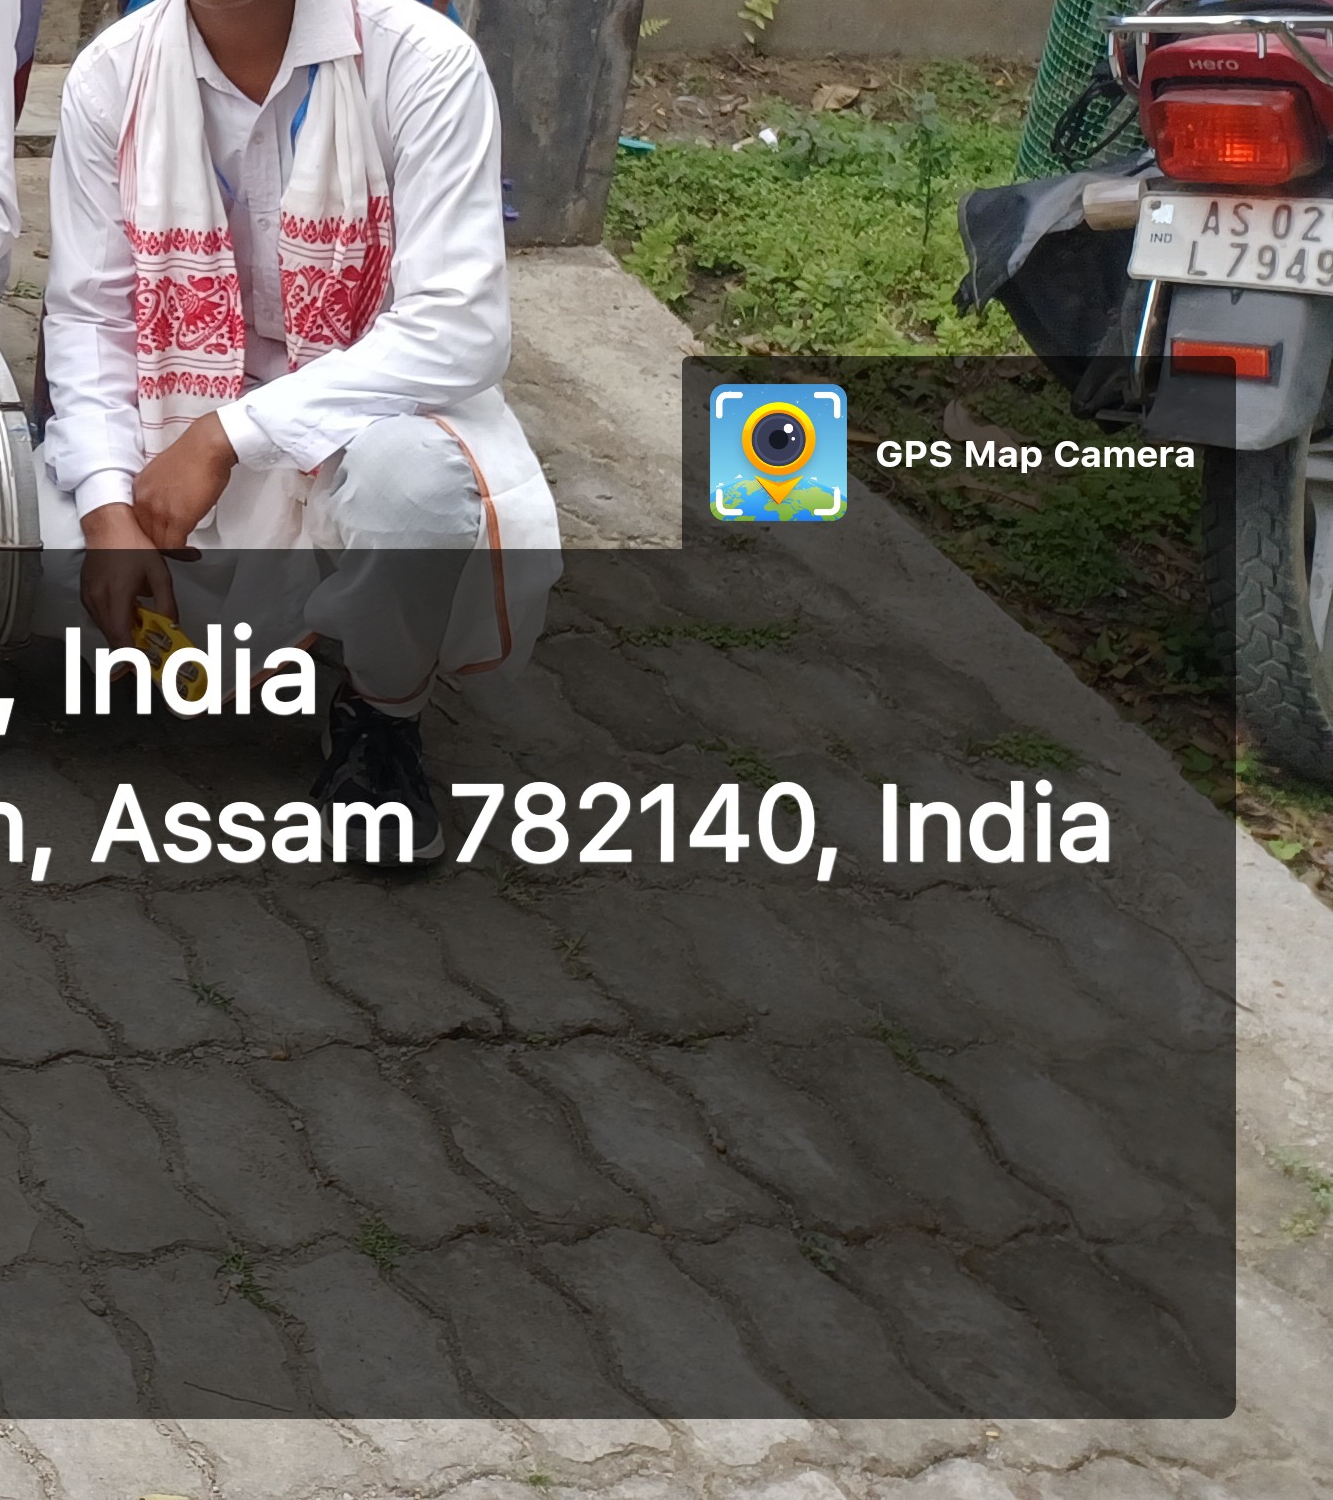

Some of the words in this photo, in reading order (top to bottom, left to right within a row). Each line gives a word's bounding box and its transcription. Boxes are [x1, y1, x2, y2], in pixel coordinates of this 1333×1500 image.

[1188, 58, 1240, 71] Hero
[1201, 201, 1253, 236] AS
[1271, 204, 1324, 242] 02
[1150, 232, 1173, 244] IND
